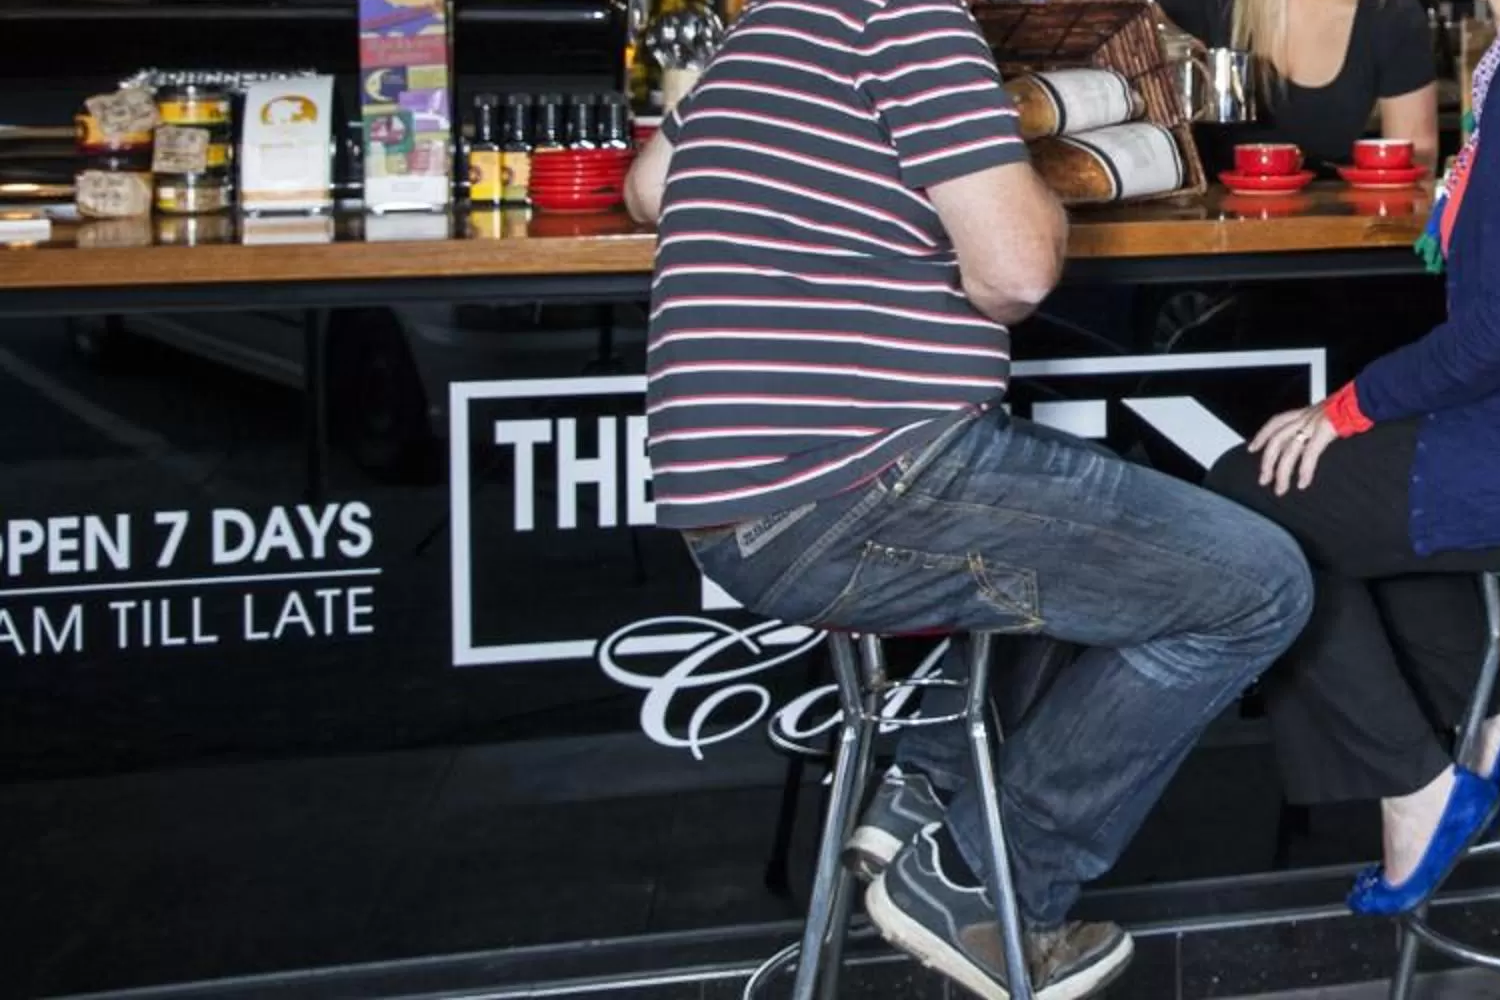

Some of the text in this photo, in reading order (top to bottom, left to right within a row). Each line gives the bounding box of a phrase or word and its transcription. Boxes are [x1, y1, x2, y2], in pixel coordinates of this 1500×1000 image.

[0, 501, 374, 576] PEN 7 DAYS
[109, 597, 219, 649] TILL
[244, 586, 375, 641] LATE
